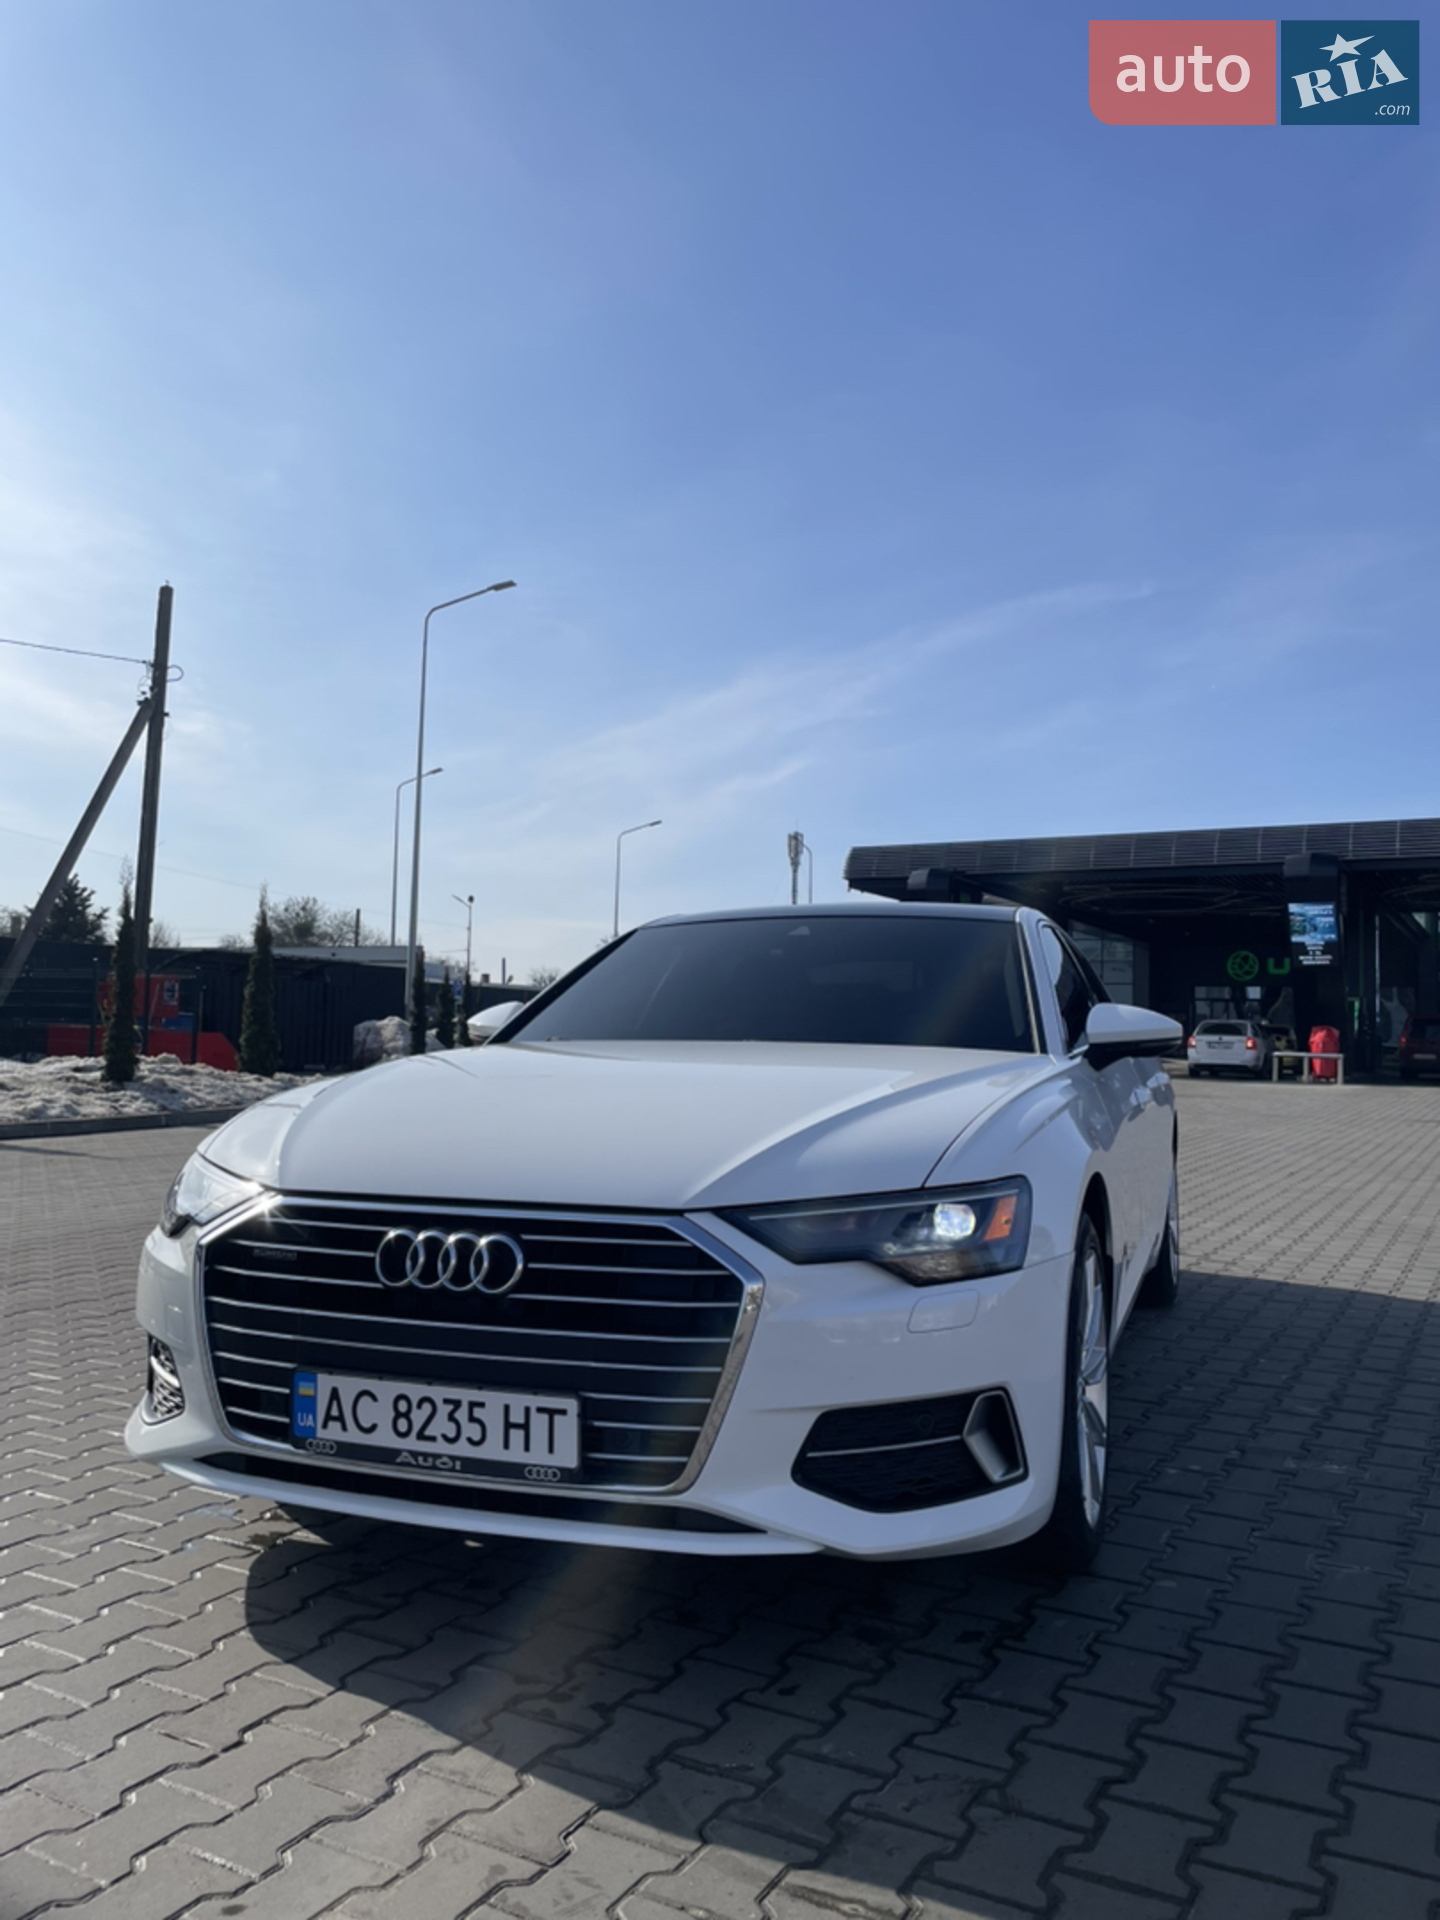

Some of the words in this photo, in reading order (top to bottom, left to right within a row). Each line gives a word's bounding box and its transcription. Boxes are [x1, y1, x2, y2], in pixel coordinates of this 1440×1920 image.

[297, 1413, 316, 1428] UA
[321, 1386, 378, 1435] AC
[391, 1393, 488, 1447] 8235
[502, 1403, 569, 1455] HT
[395, 1451, 462, 1471] Audi
